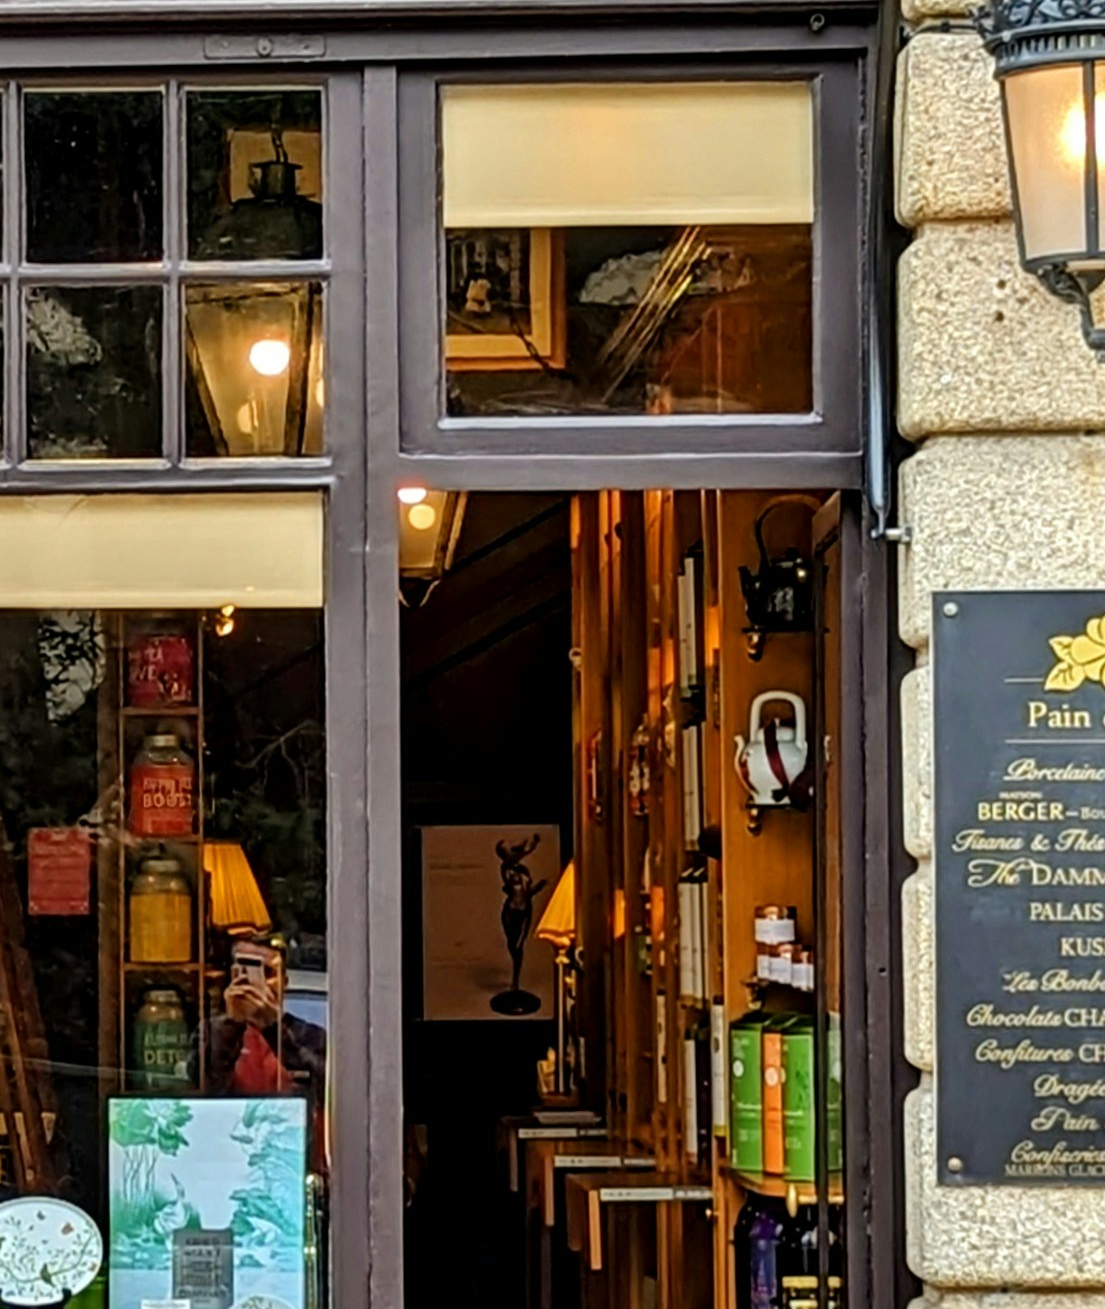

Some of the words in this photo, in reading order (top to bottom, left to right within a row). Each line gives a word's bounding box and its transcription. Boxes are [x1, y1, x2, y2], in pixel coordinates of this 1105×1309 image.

[1027, 701, 1092, 729] Pain
[978, 801, 1065, 821] BERGER
[1029, 901, 1104, 922] PALAIS
[1060, 936, 1105, 957] KUS
[966, 1003, 1062, 1027] Chocolats
[975, 1038, 1074, 1069] Confitures
[1030, 1106, 1100, 1131] Pain
